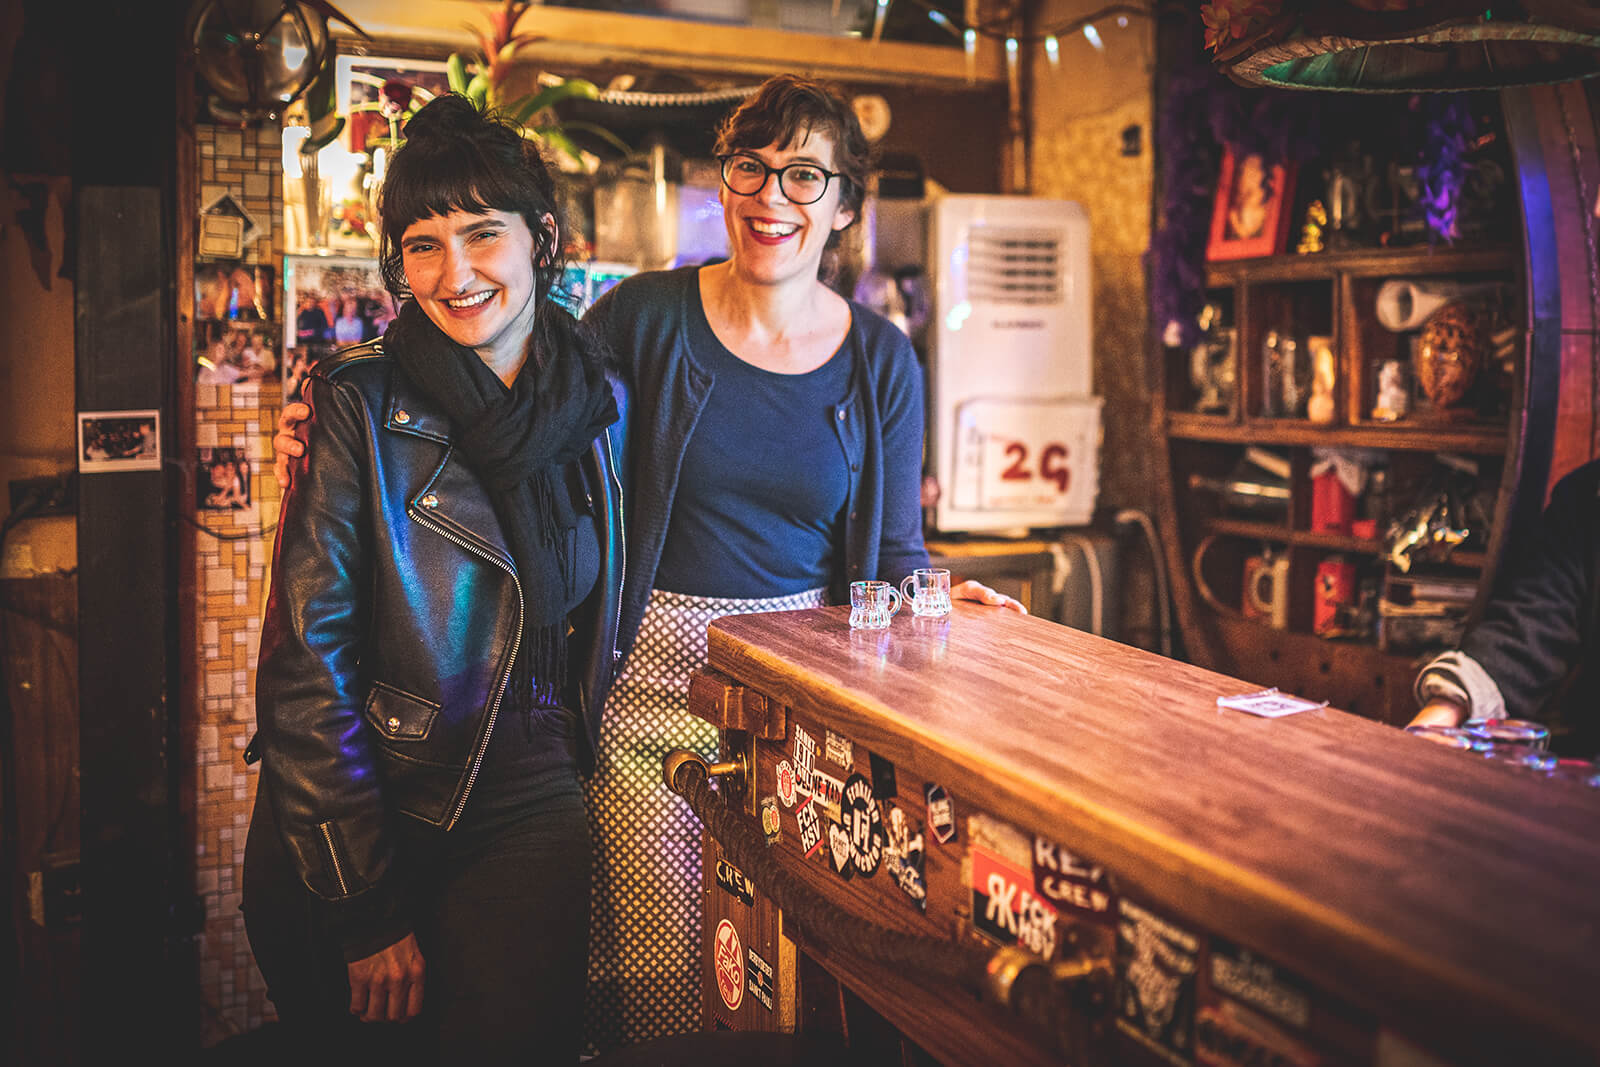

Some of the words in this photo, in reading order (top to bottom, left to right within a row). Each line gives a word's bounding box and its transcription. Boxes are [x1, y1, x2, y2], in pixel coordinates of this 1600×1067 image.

[796, 800, 818, 834] FCK
[801, 819, 821, 853] HSV
[1018, 890, 1058, 931] FCK
